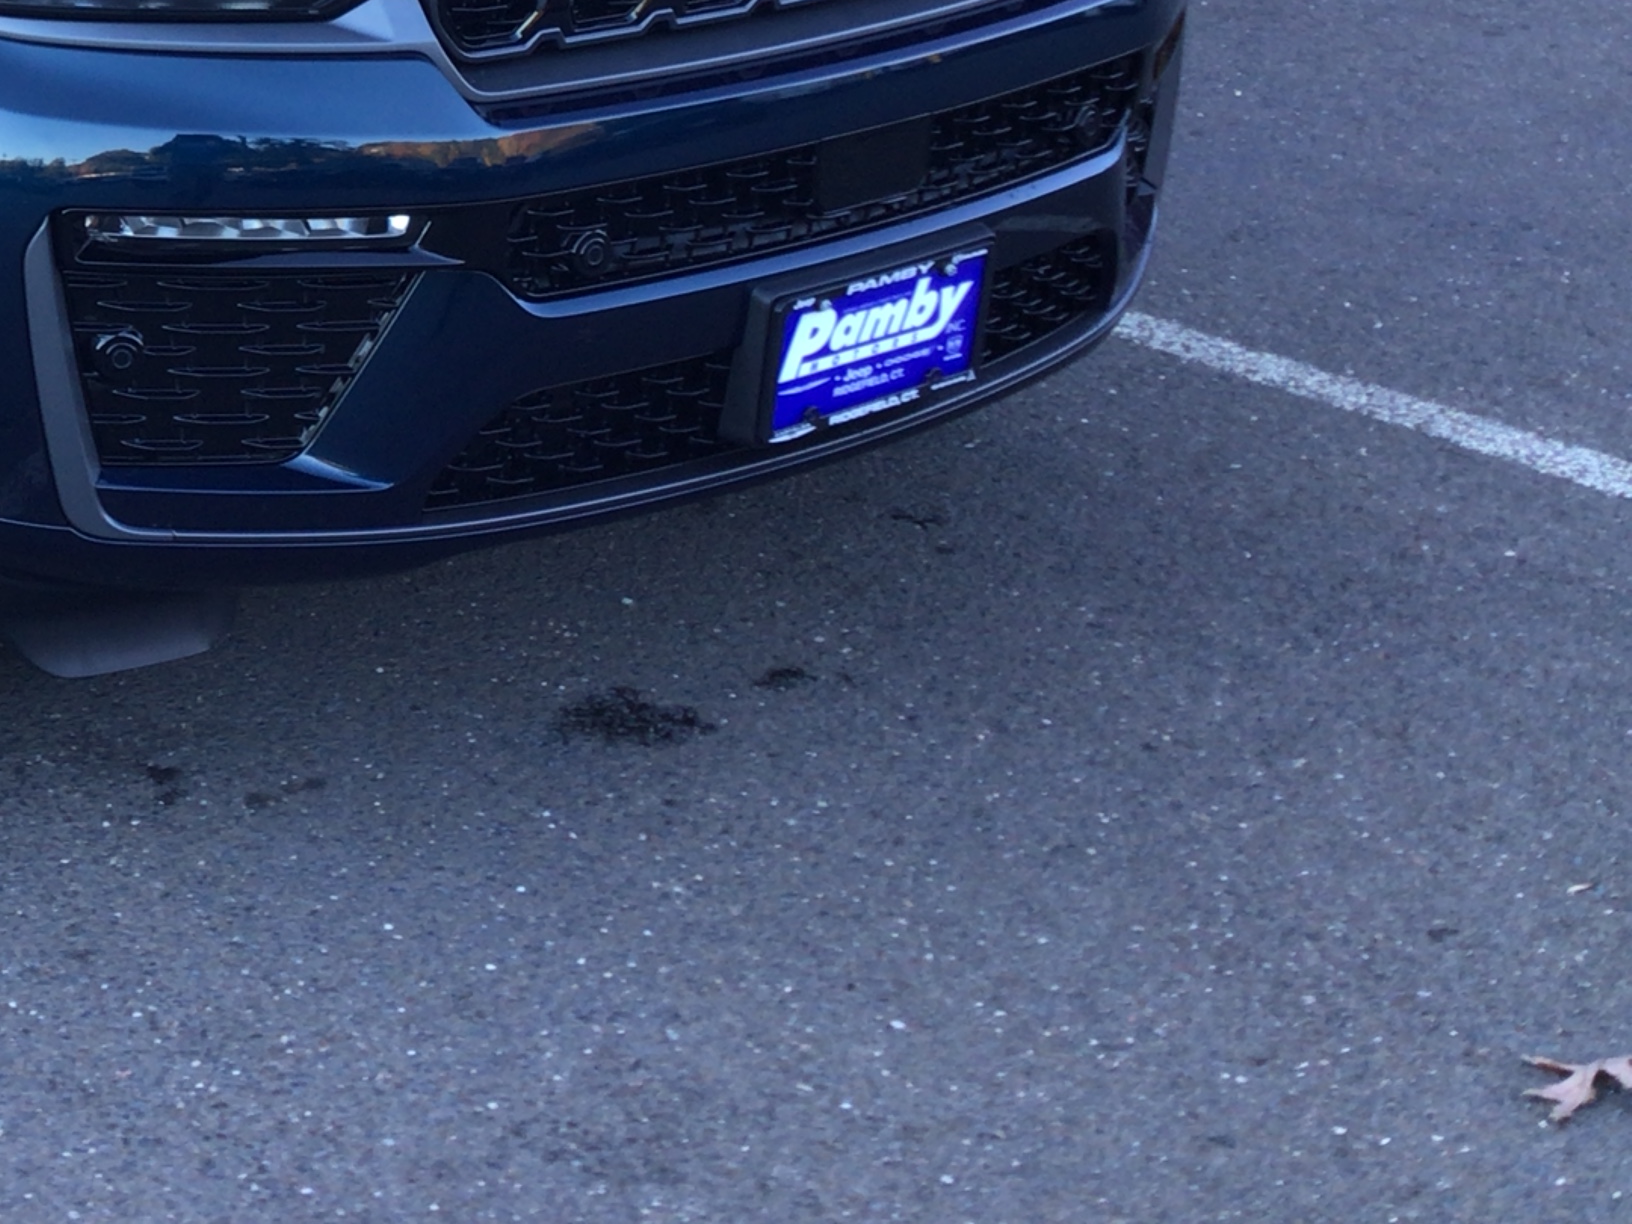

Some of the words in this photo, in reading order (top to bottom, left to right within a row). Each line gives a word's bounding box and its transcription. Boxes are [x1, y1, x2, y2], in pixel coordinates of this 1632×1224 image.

[846, 260, 935, 296] PAMBY
[777, 276, 975, 383] Pamby
[842, 364, 873, 382] Jeep
